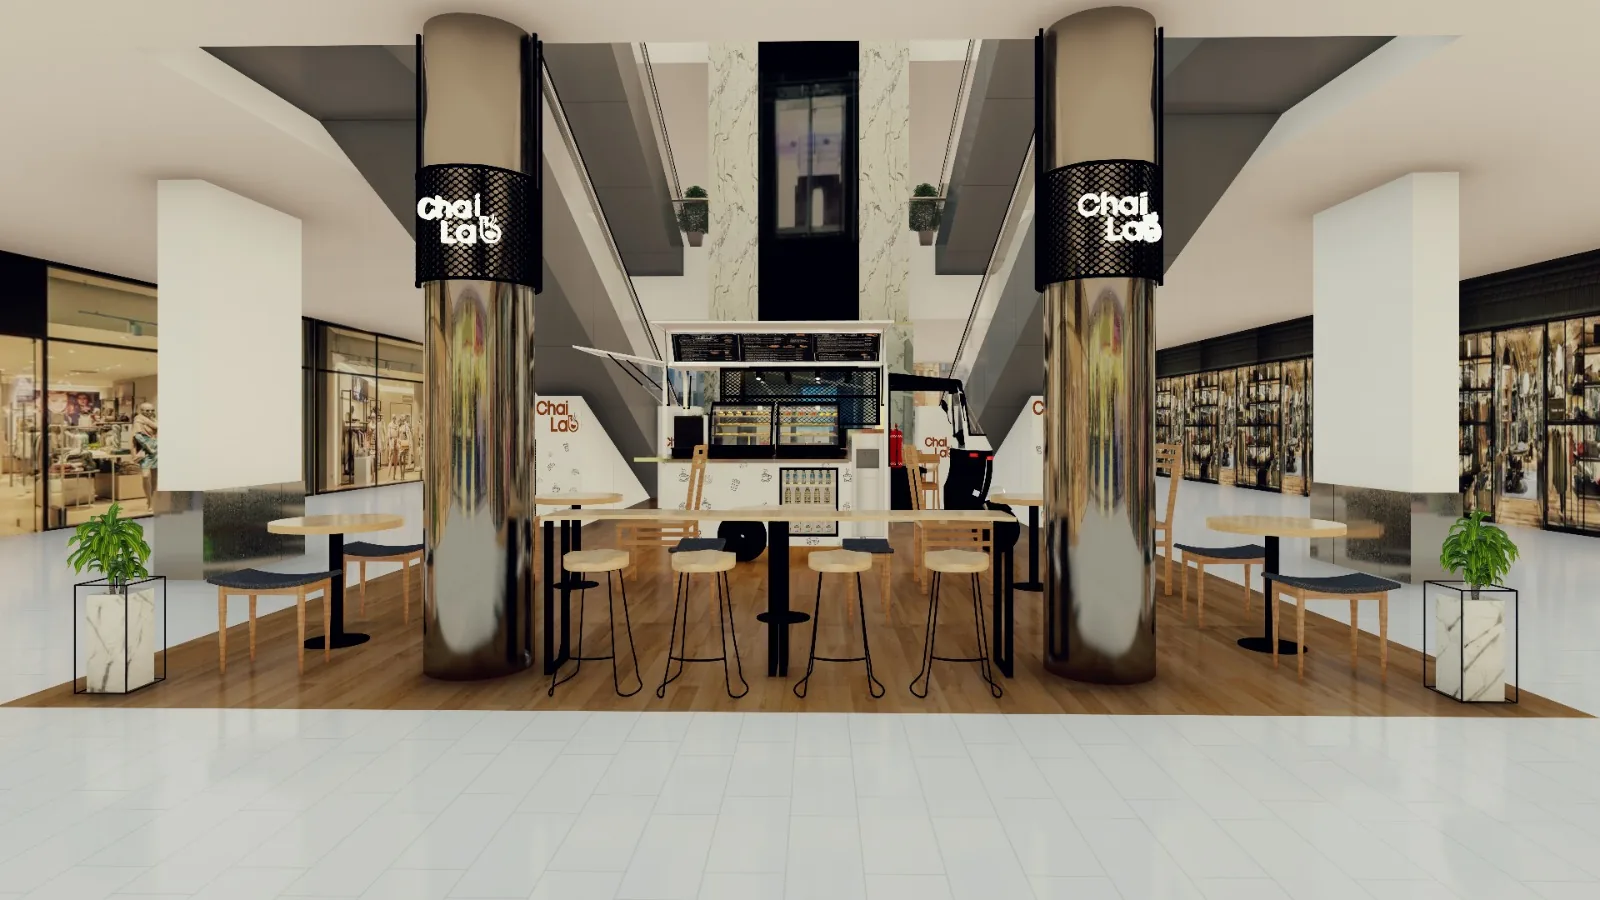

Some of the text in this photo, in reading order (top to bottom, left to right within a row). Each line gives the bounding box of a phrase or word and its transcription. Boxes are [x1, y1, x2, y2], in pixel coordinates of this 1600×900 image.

[417, 193, 481, 220] Chai
[1077, 191, 1148, 217] Chai
[440, 215, 502, 244] Lab
[1105, 212, 1162, 243] Lab
[536, 401, 569, 416] Chai
[550, 413, 579, 433] Lab
[924, 437, 948, 447] Chai
